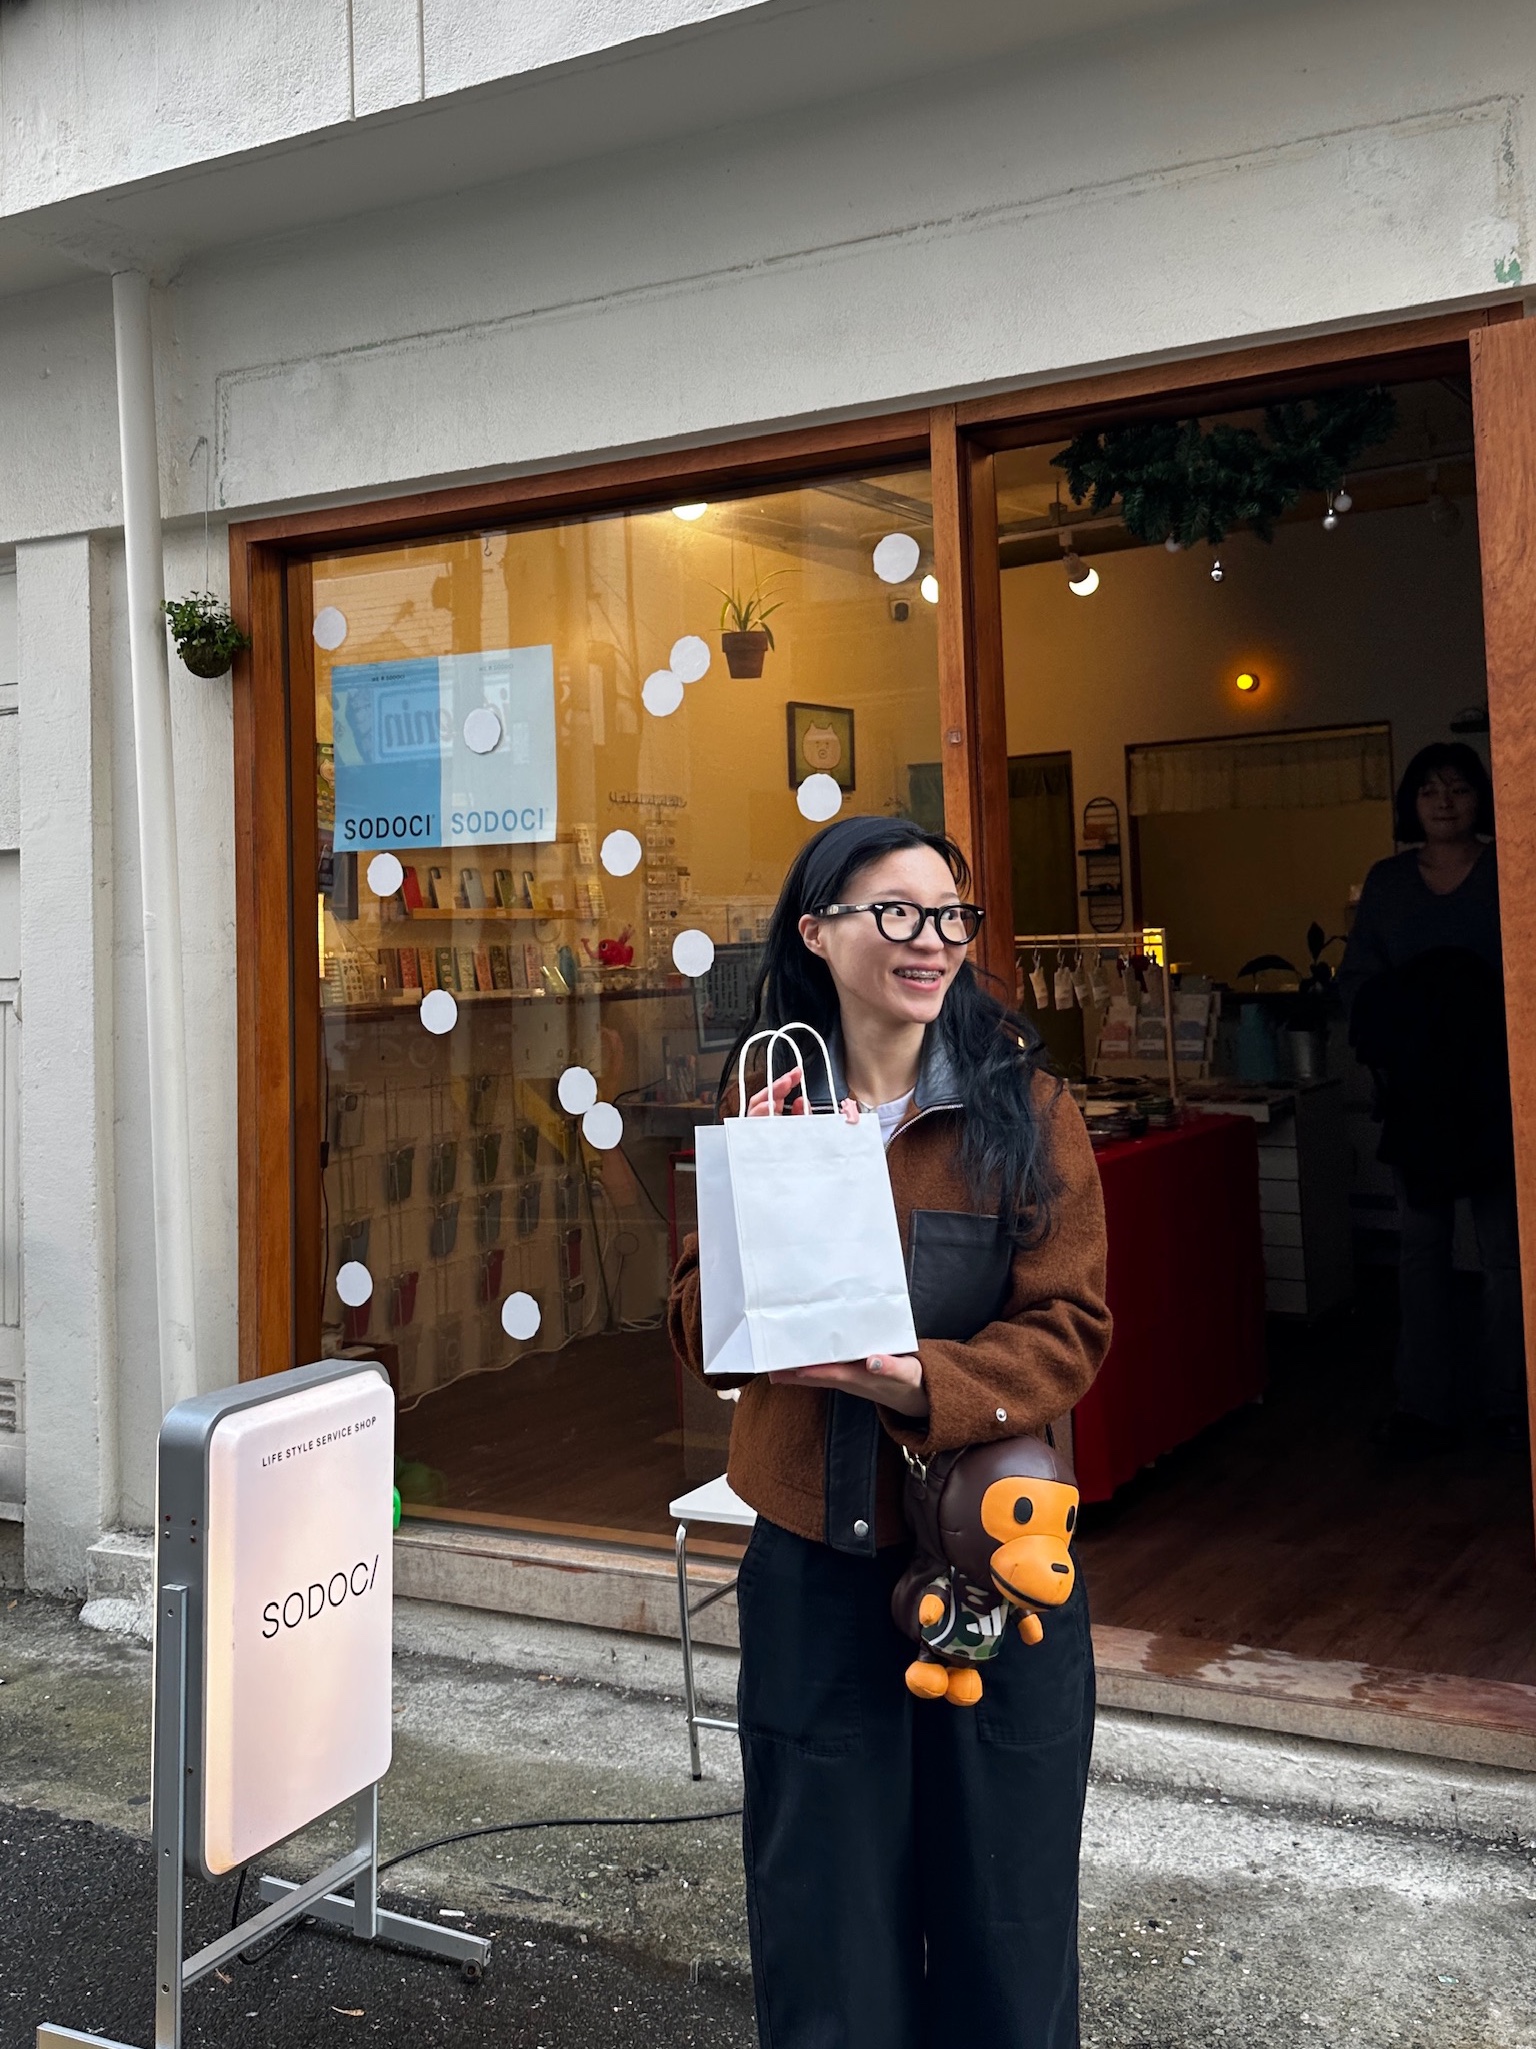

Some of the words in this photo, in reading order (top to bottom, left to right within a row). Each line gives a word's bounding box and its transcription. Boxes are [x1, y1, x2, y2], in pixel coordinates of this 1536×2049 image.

[344, 815, 430, 840] SODOCI
[452, 808, 543, 834] SODOCI
[262, 1451, 283, 1467] LIFE
[286, 1440, 314, 1459] STYLE
[316, 1425, 352, 1447] SERVICE
[354, 1416, 377, 1433] SHOP
